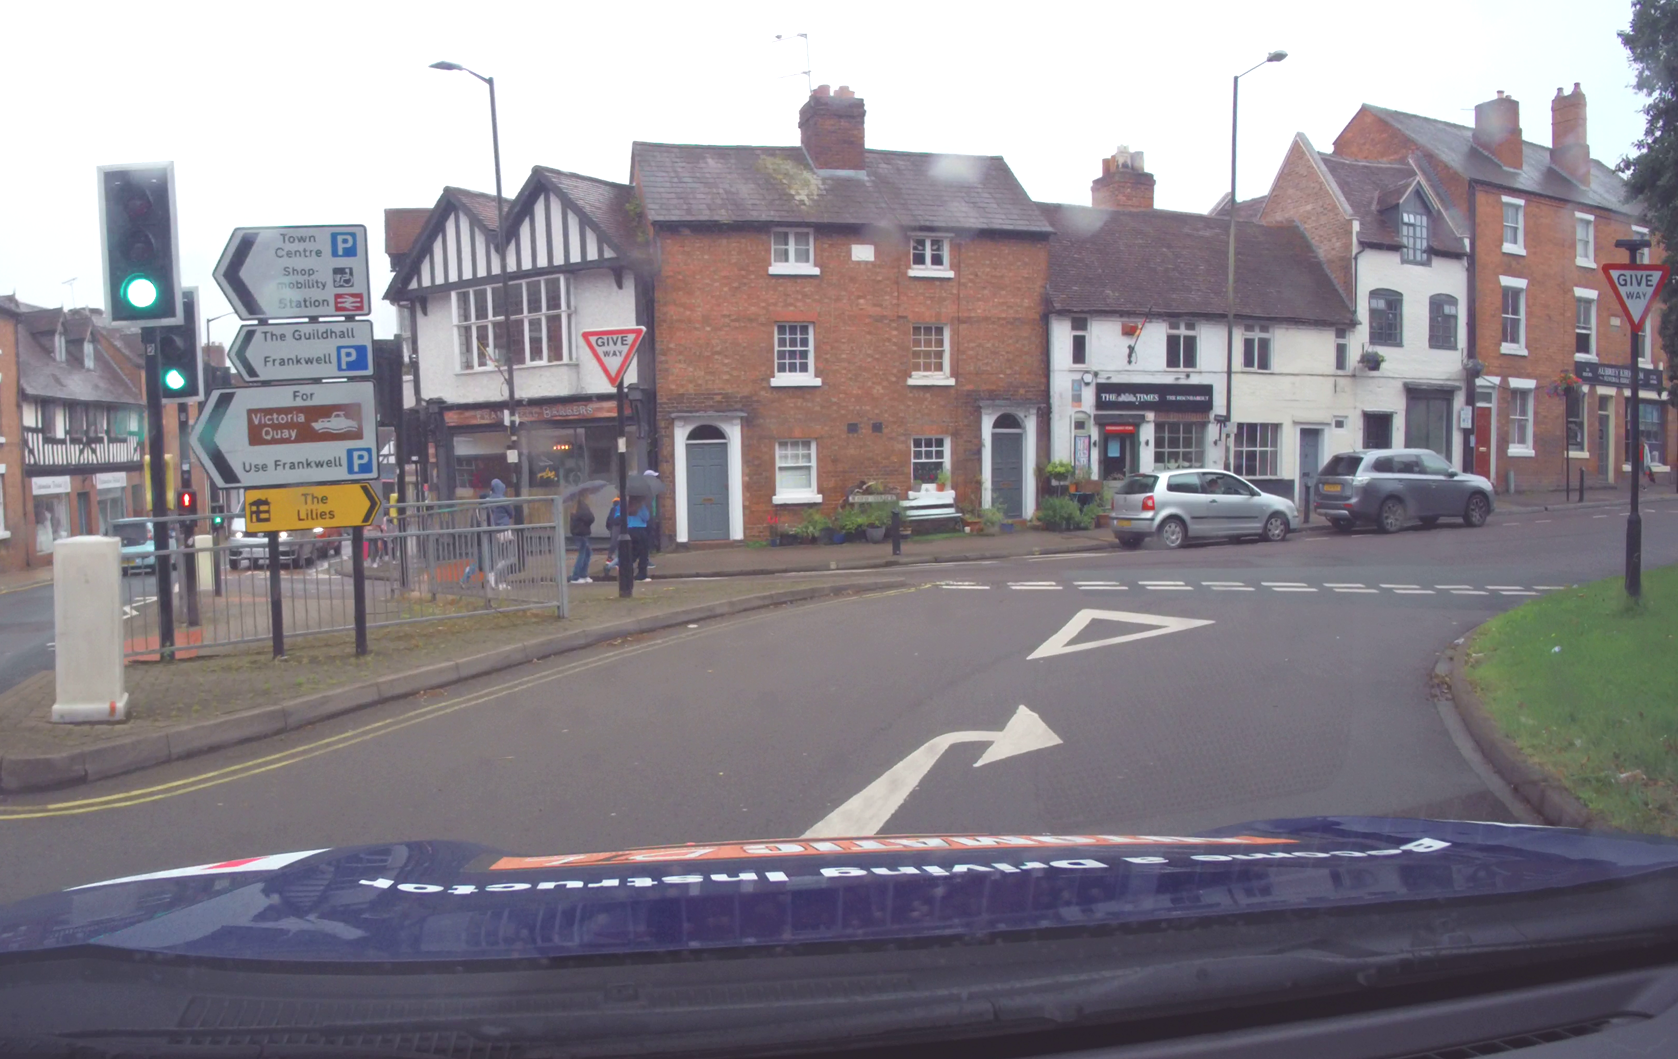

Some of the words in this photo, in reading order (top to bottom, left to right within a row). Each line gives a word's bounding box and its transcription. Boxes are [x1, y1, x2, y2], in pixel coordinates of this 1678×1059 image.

[280, 233, 316, 244] Town
[337, 234, 354, 256] P
[275, 247, 323, 259] Centre
[283, 266, 319, 278] Shop-
[277, 278, 327, 291] mobility
[1617, 273, 1655, 287] GIVE
[1626, 291, 1648, 300] WAY
[278, 297, 330, 310] Station
[261, 330, 287, 343] The
[292, 327, 355, 341] Guildhall
[595, 335, 629, 347] GIVE
[263, 353, 333, 367] Frankwell
[340, 348, 357, 370] P
[602, 350, 624, 358] WAY
[292, 390, 315, 402] For
[1101, 393, 1117, 402] THE
[1135, 393, 1159, 402] TIMES
[251, 411, 306, 425] Victoria
[262, 427, 297, 441] Quay
[242, 460, 269, 473] Use
[274, 456, 343, 471] Frankwell
[353, 450, 369, 473] P
[301, 493, 329, 505] The
[297, 509, 336, 522] Lilies
[1191, 838, 1452, 862] Become
[1121, 856, 1169, 864] a
[820, 858, 1109, 878] Driving
[359, 871, 790, 895] Instructor
